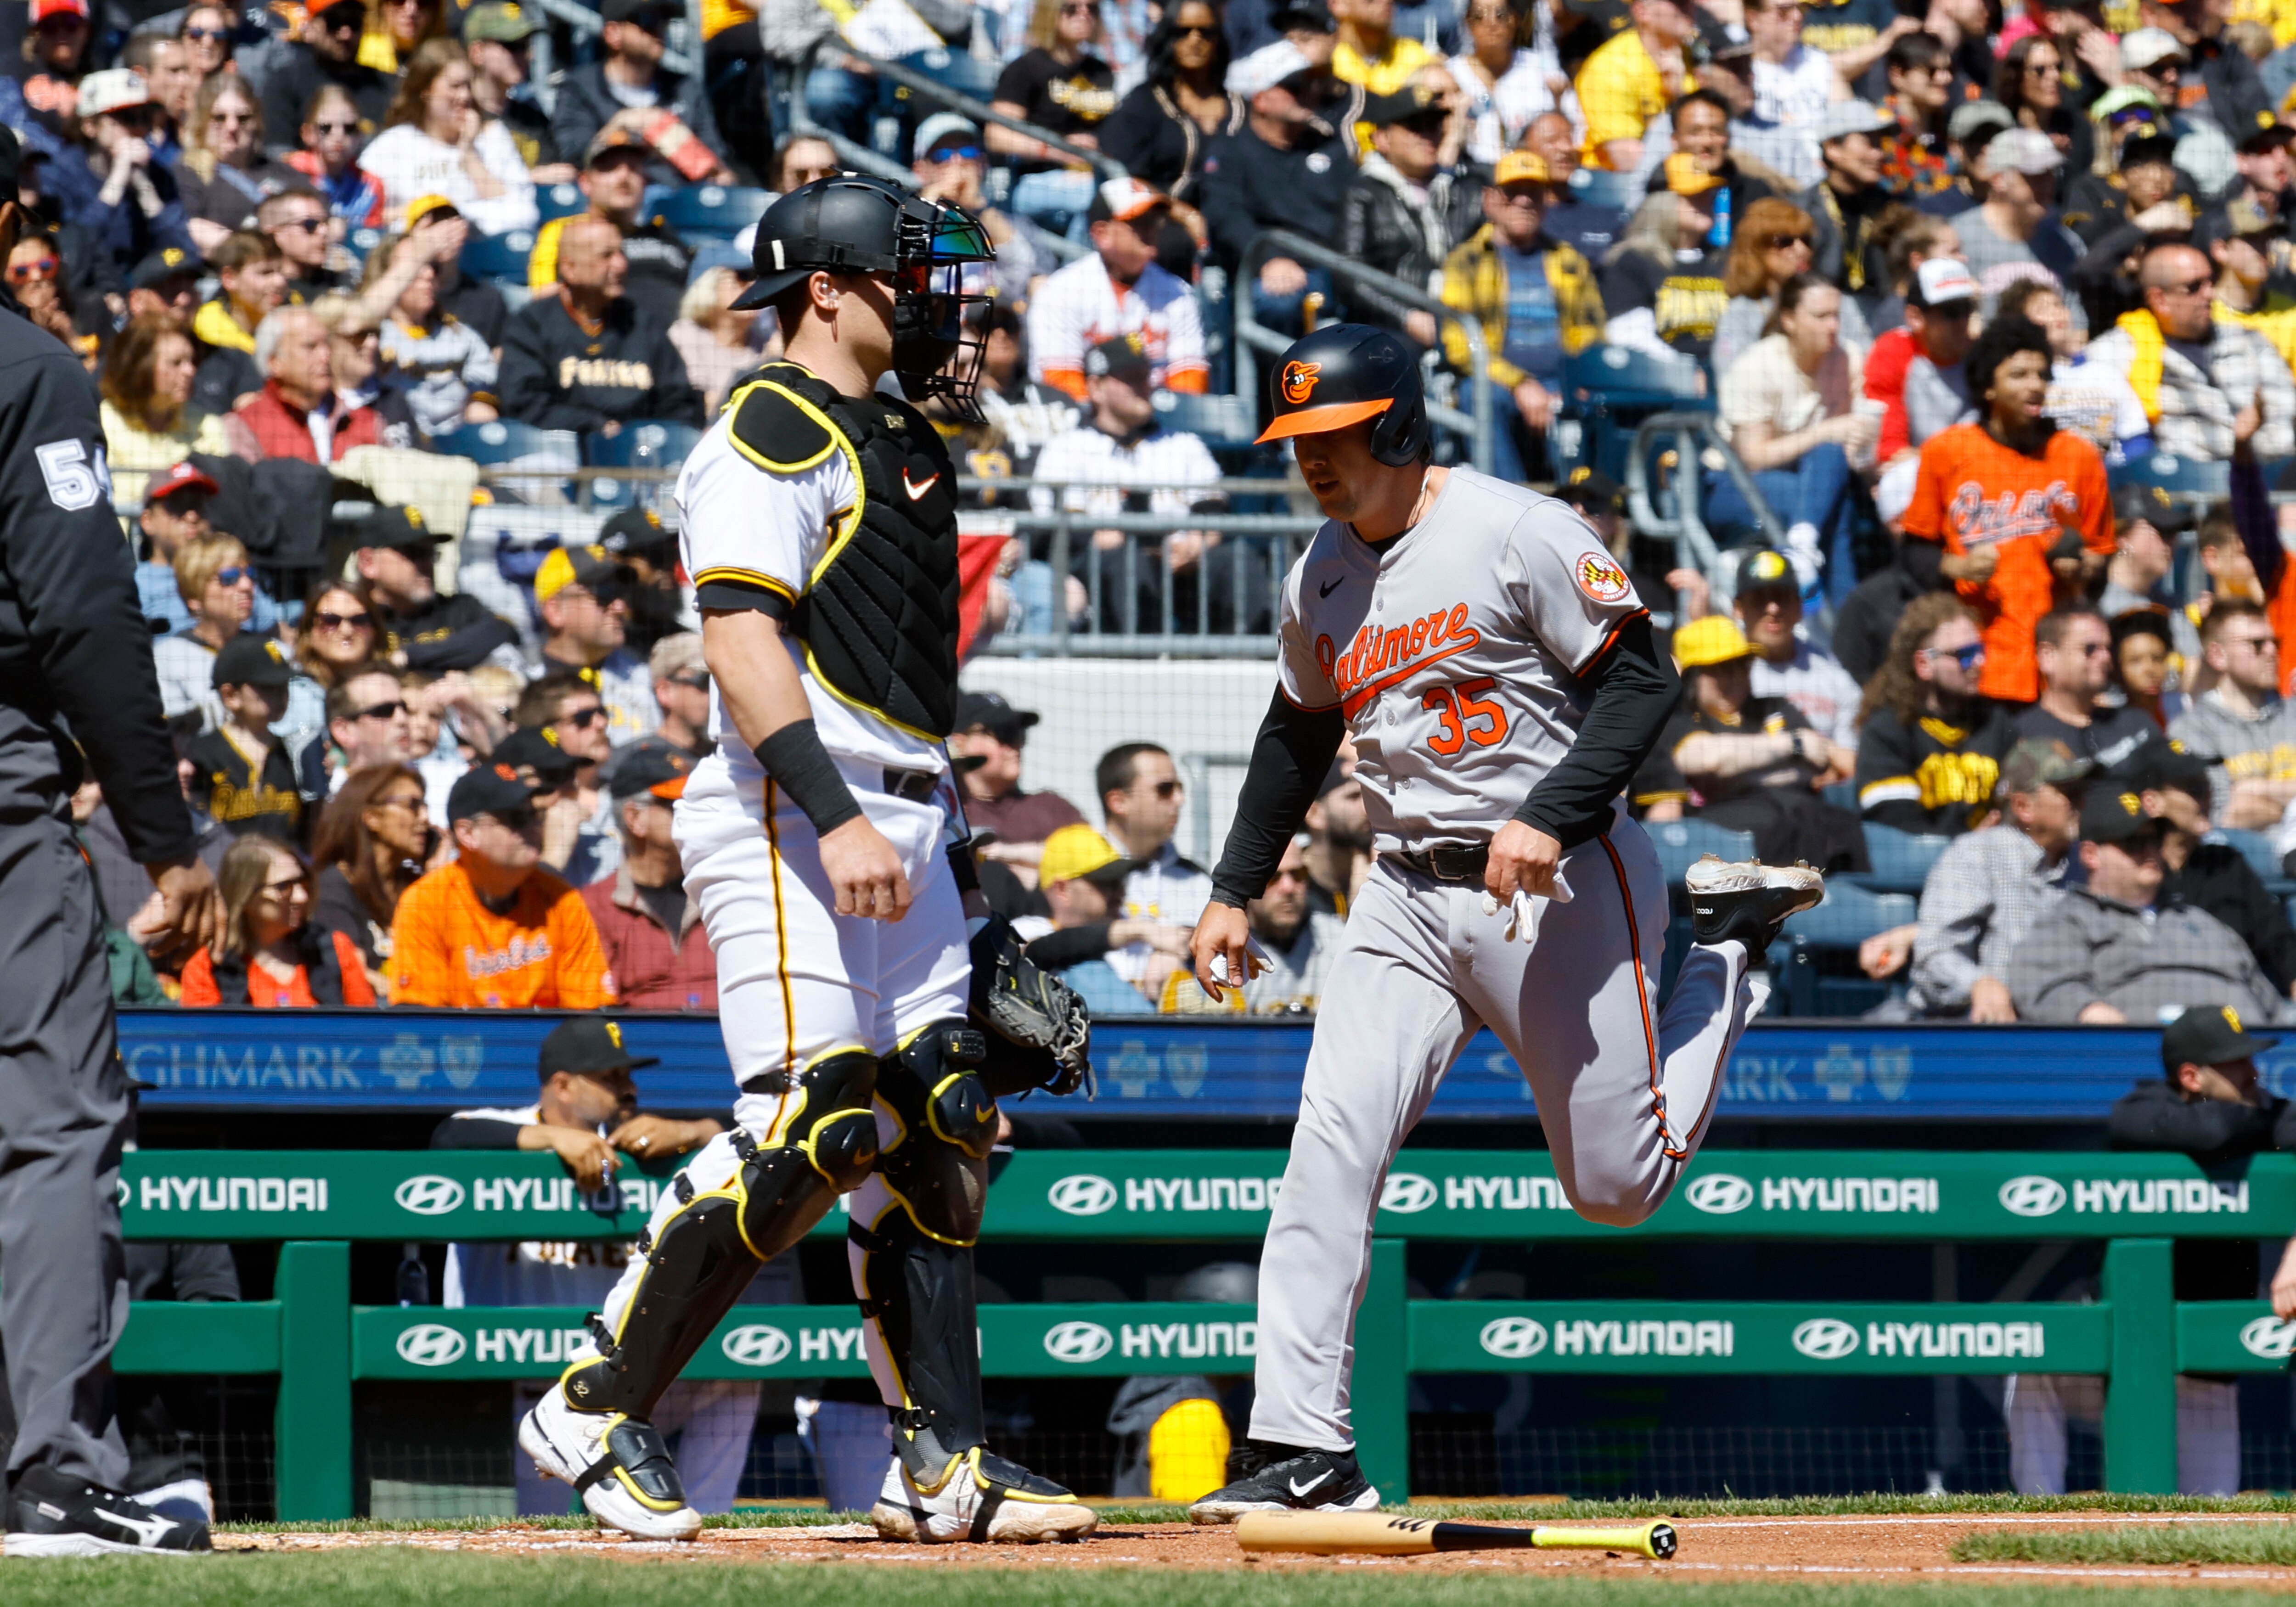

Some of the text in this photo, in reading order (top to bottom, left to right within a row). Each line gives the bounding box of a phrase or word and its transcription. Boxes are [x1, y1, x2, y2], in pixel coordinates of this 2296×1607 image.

[35, 438, 113, 511] 5
[1603, 580, 1629, 600] ORIOLES
[1315, 602, 1480, 705] Baltimore
[1422, 677, 1508, 755] 35
[127, 1043, 362, 1090] GHMARK
[141, 1176, 328, 1211] HYUNDAI
[1445, 1176, 1573, 1210] HYUN
[1761, 1178, 1939, 1212] HYUNDAI
[2073, 1180, 2249, 1213] HYUNDAI
[476, 1328, 590, 1363] HYUN
[1121, 1321, 1258, 1360] HYUND
[1554, 1320, 1733, 1357] HYUNDAI
[1867, 1322, 2044, 1357] HYUNDAI
[573, 1380, 589, 1398] 32
[1660, 1535, 1669, 1548] 6
